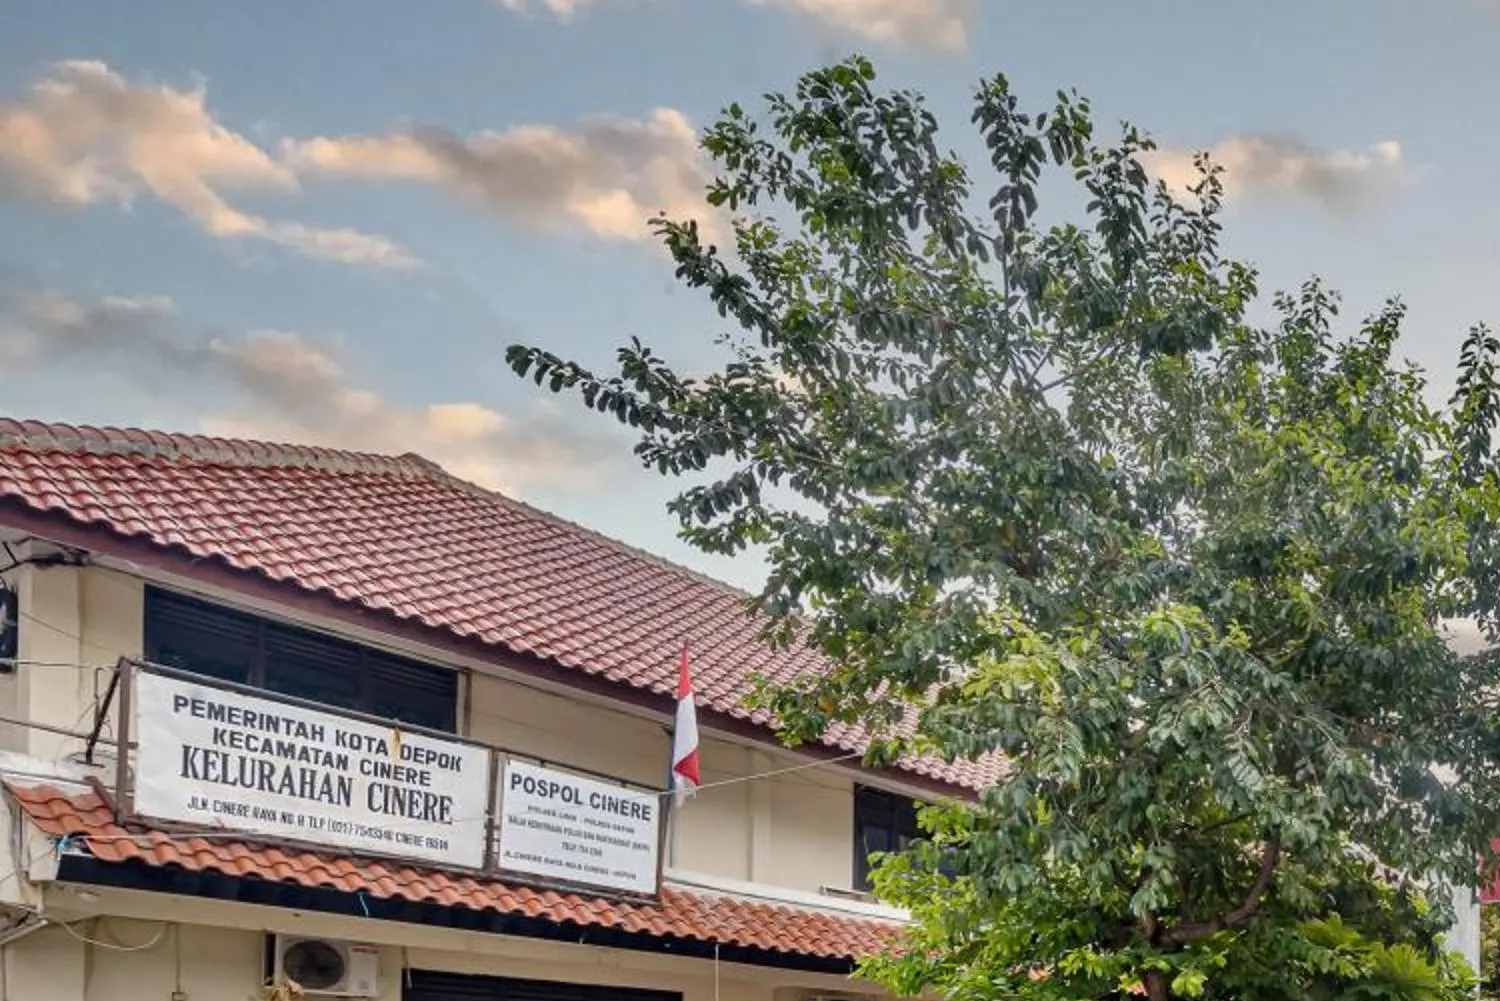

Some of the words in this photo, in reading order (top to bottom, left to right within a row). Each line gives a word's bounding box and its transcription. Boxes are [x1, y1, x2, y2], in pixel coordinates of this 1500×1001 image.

[174, 693, 325, 742] PEMERINTAH
[335, 729, 388, 756] KOTA
[400, 743, 462, 772] DEPOK
[213, 726, 348, 771] KECAMATAN
[360, 758, 431, 787] CINERE
[180, 744, 353, 807] KELURAHAN
[367, 782, 453, 825] CINERE
[213, 799, 250, 818] CINERE
[511, 772, 584, 806] POSPOL
[589, 791, 651, 822] CINERE
